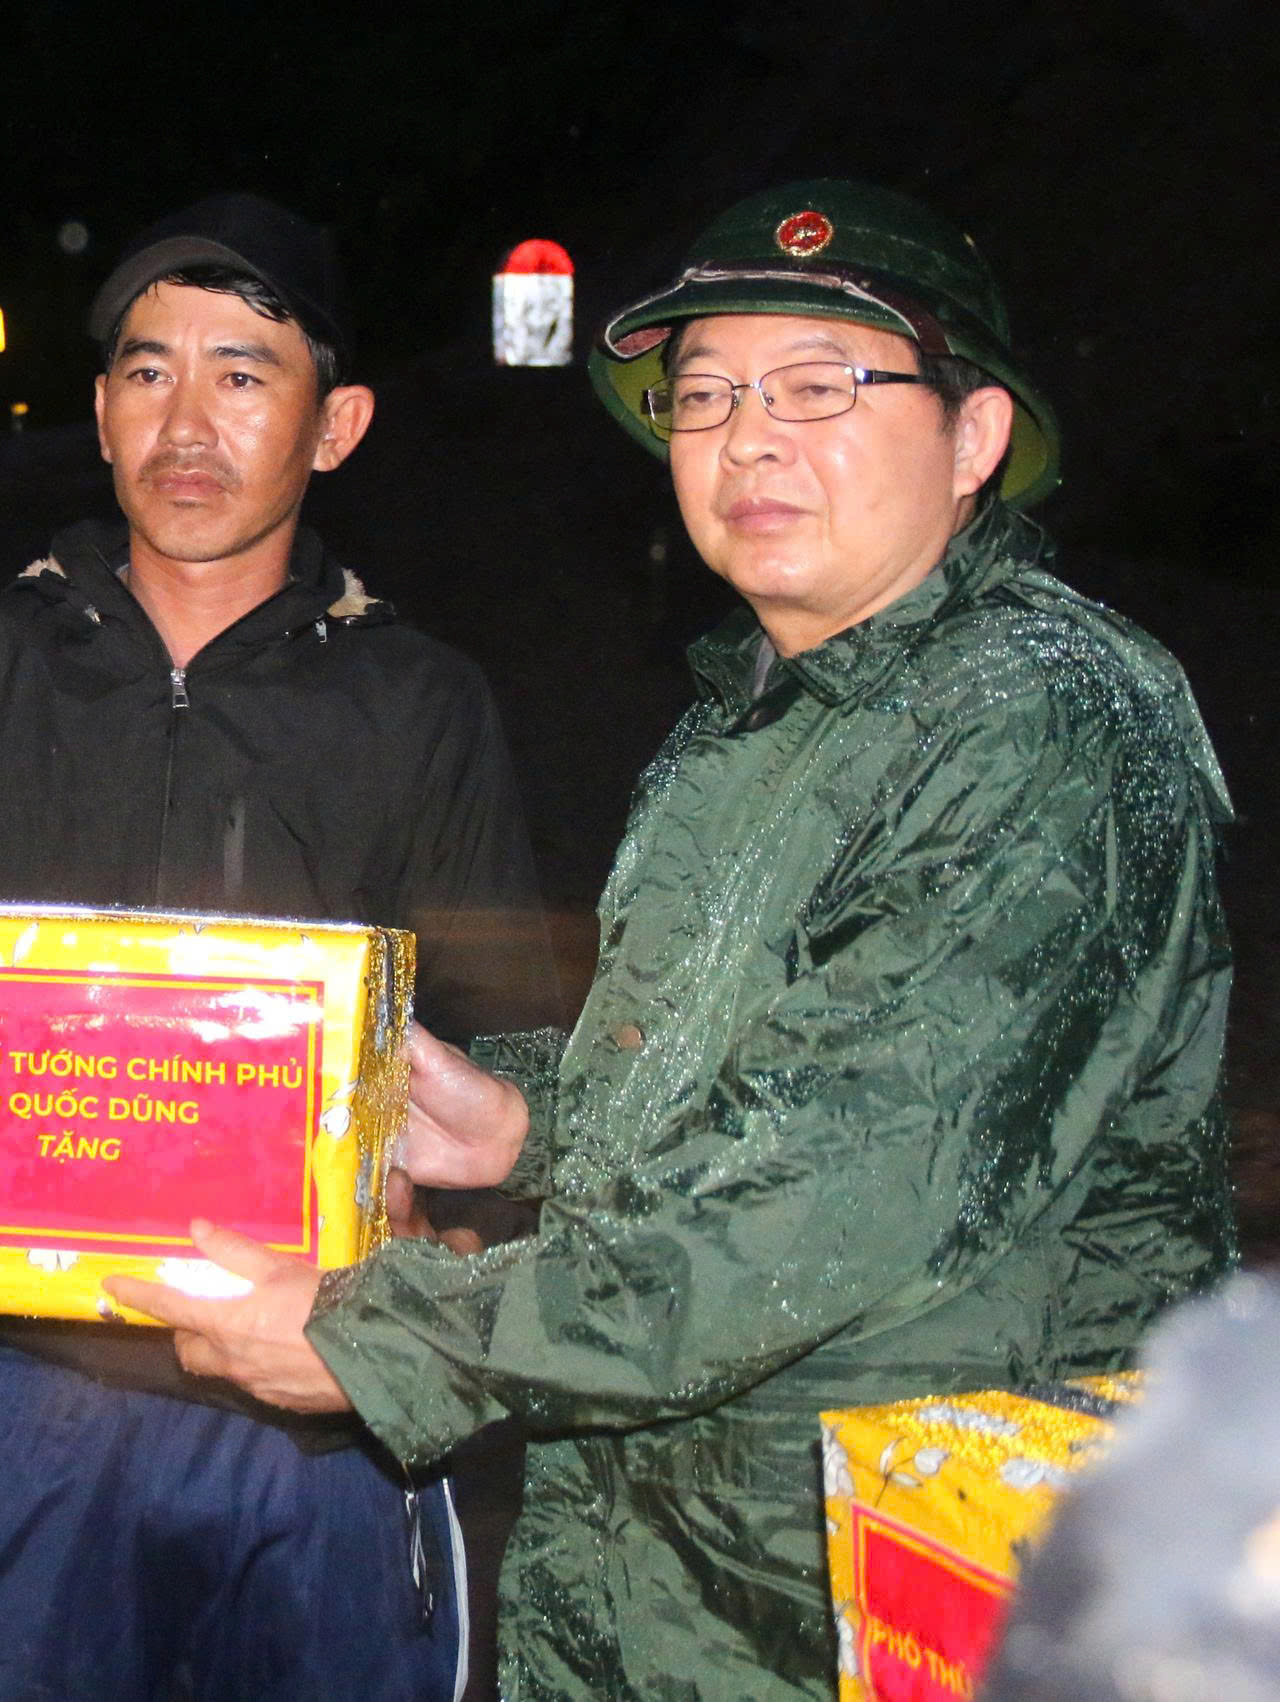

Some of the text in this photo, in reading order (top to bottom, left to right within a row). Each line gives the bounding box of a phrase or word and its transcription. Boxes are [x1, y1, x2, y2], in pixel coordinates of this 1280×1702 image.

[8, 1048, 118, 1080] TƯỚNG
[126, 1054, 227, 1085] CHÍNH
[237, 1056, 303, 1089] PHỦ
[8, 1088, 99, 1120] QUỐC
[108, 1092, 200, 1125] DŨNG
[37, 1130, 121, 1164] TẶNG
